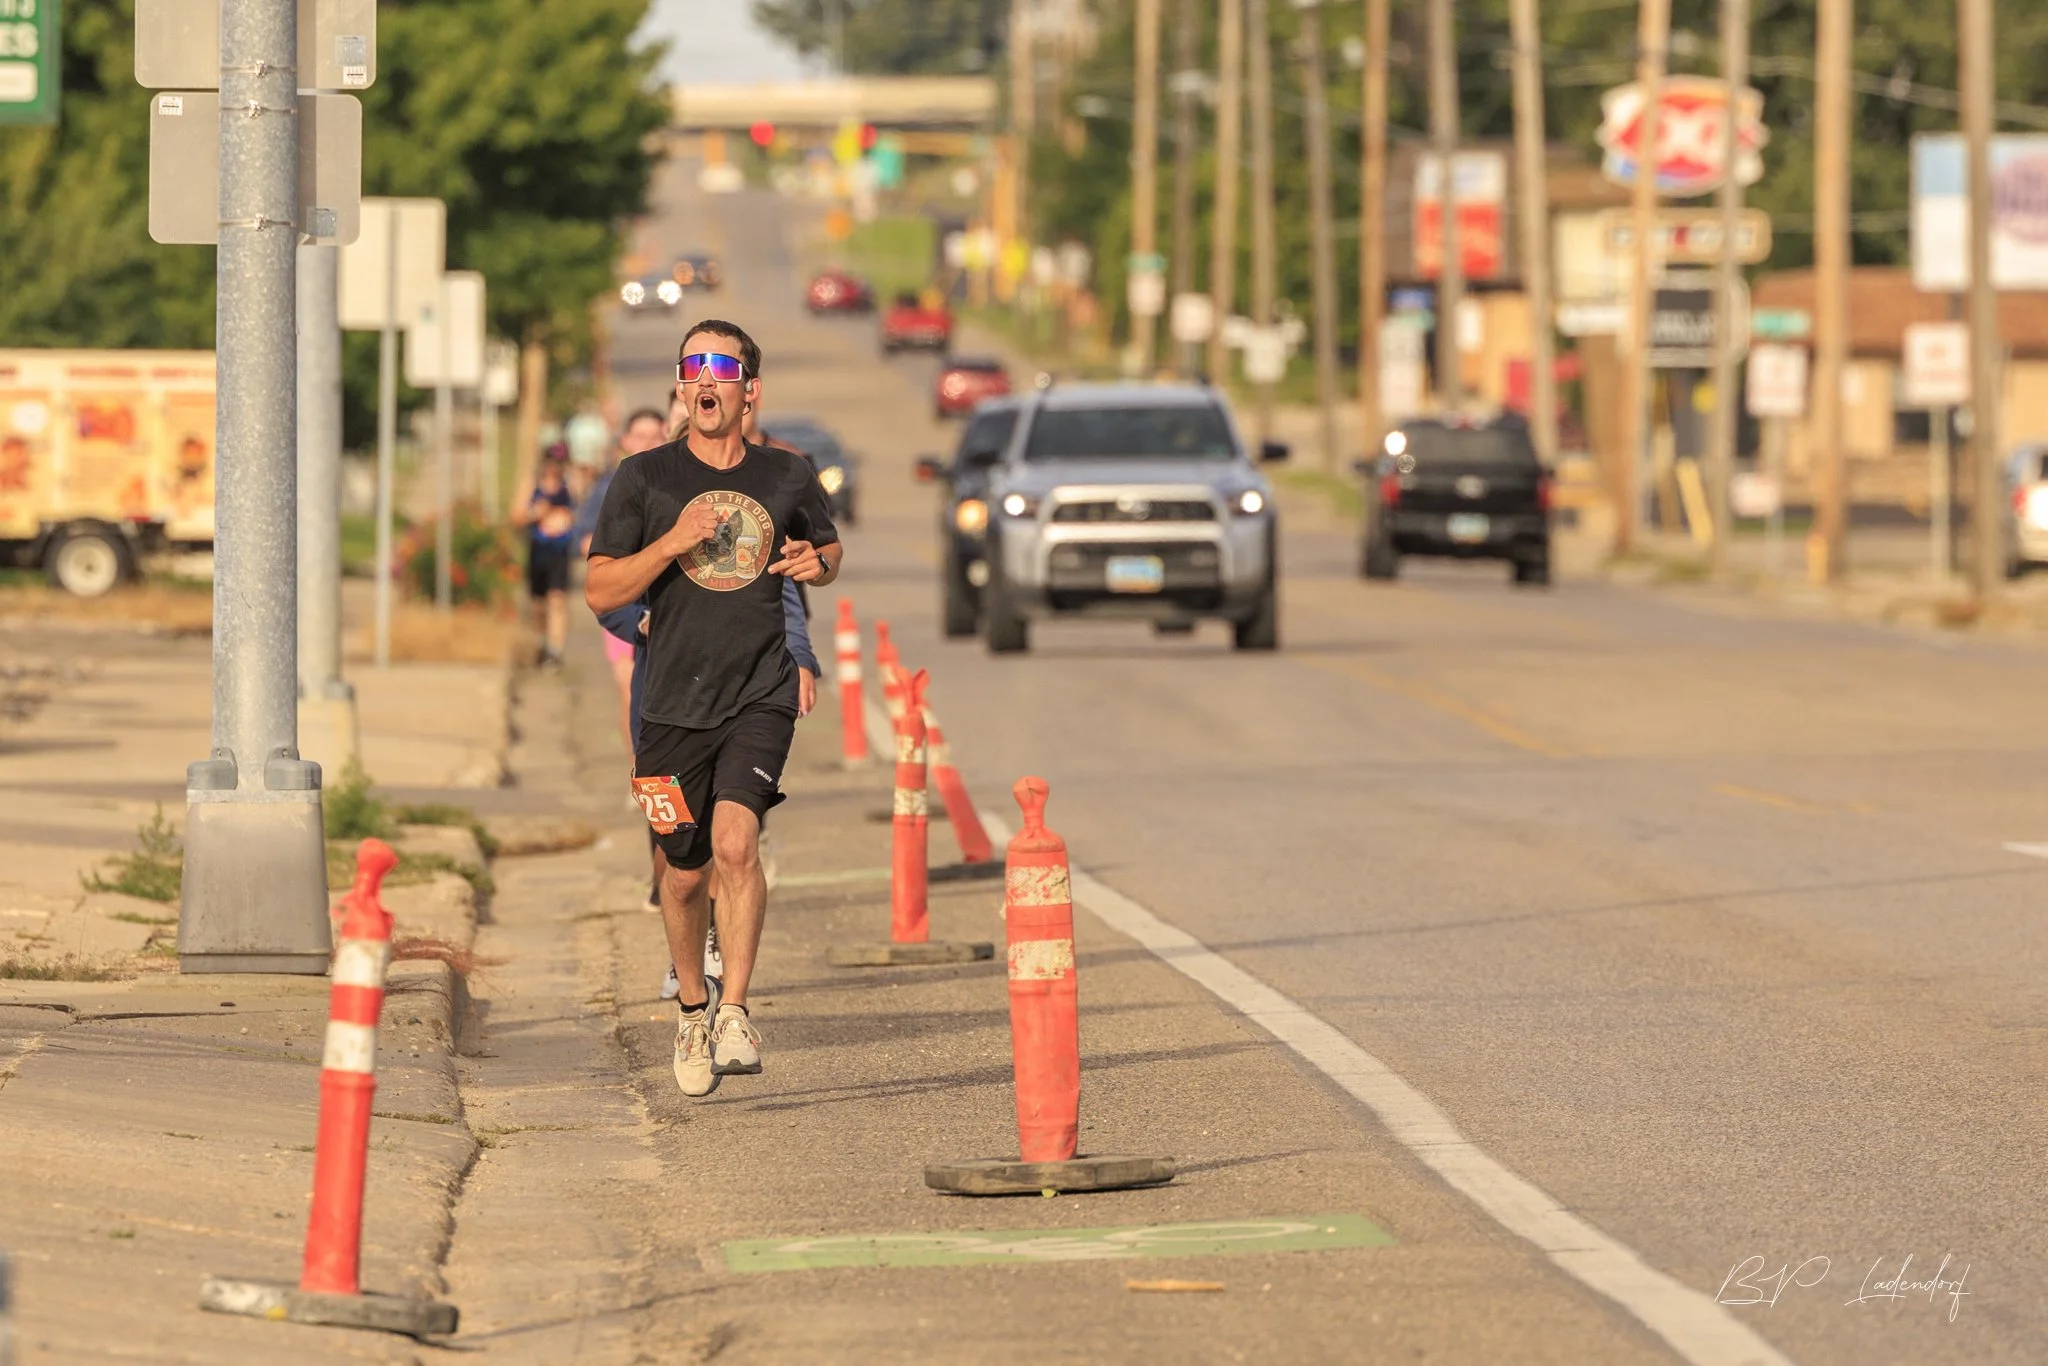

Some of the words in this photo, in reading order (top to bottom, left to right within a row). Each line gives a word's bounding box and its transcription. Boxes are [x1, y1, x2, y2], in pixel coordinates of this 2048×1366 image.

[705, 493, 720, 503] OF
[727, 493, 750, 508] THE
[751, 507, 771, 531] DOG
[633, 791, 677, 822] 25
